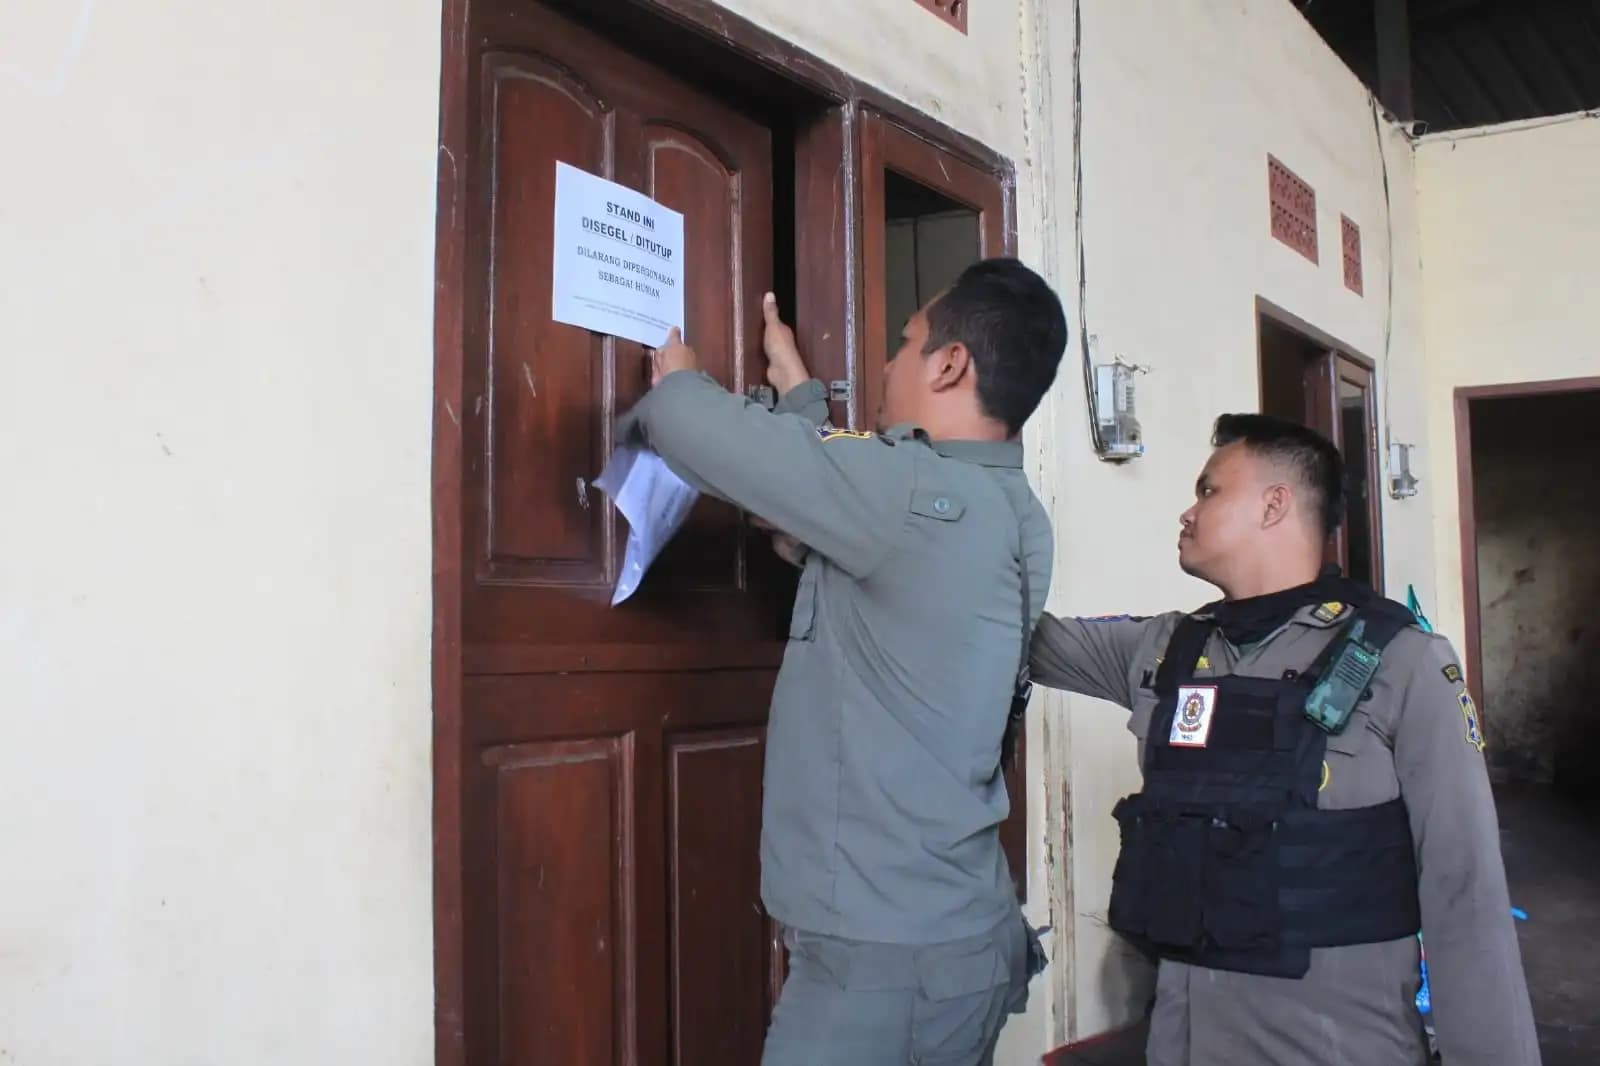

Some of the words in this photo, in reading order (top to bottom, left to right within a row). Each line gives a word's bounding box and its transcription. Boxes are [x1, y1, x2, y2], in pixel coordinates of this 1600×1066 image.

[606, 201, 640, 223] STAND
[643, 215, 655, 230] INI
[582, 216, 627, 242] DISEGEL
[635, 234, 672, 259] DITUTUP
[577, 245, 620, 267] DILARANG
[623, 259, 675, 288] DIPERGUNAKAN
[598, 269, 633, 289] SEBAGAI
[635, 281, 660, 299] HUNIAN
